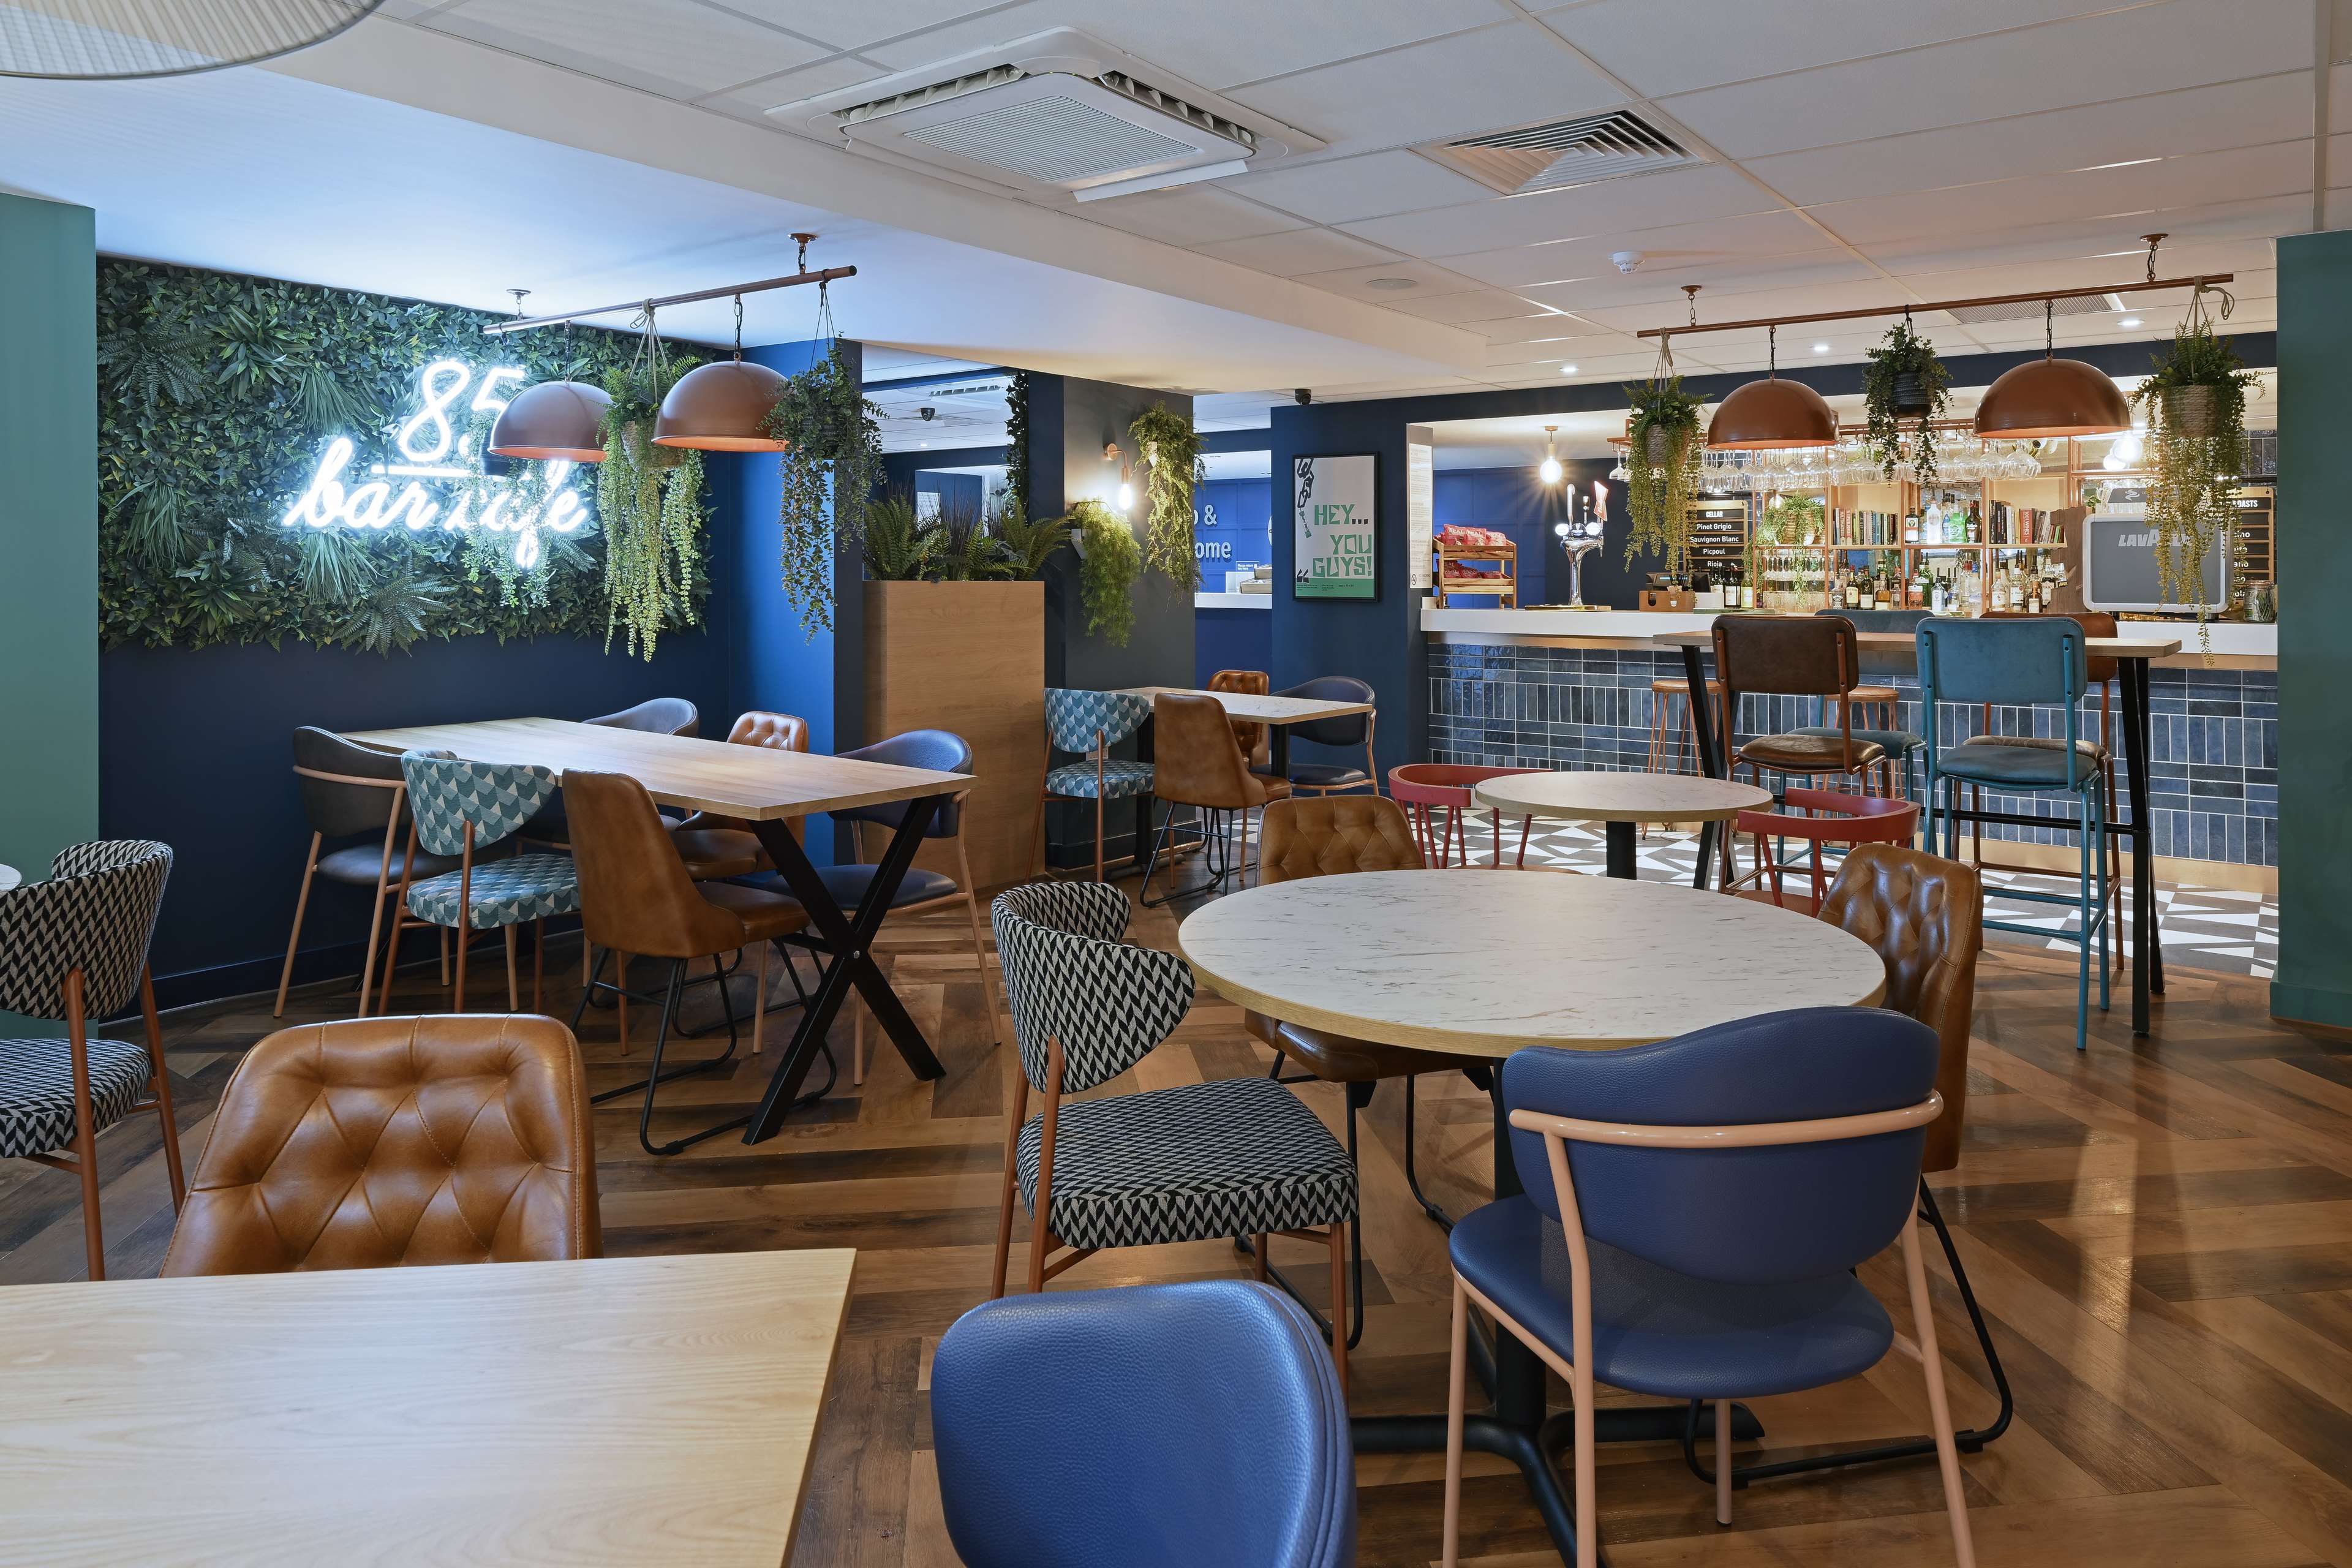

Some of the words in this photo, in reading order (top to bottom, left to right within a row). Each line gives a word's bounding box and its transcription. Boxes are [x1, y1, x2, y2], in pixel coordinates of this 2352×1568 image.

[283, 437, 439, 530] bar
[1330, 534, 1372, 555] YOU
[1313, 556, 1372, 578] GUYS!
